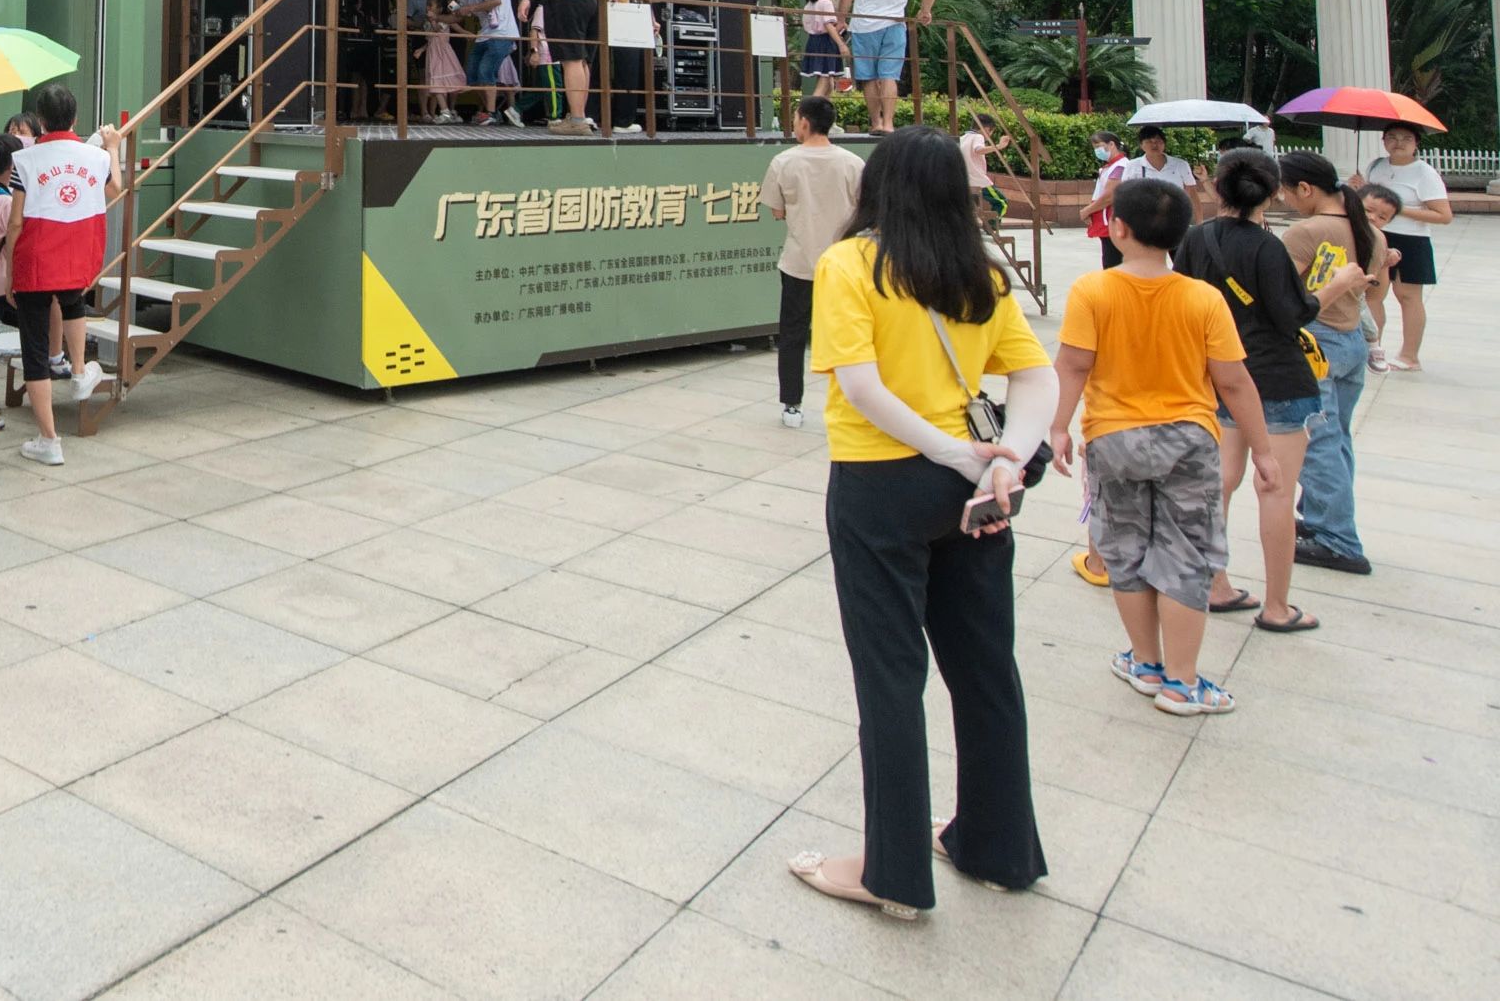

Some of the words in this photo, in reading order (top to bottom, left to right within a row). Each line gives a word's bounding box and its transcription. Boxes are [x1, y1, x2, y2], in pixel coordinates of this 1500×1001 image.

[37, 163, 97, 187] 佛山志愿者
